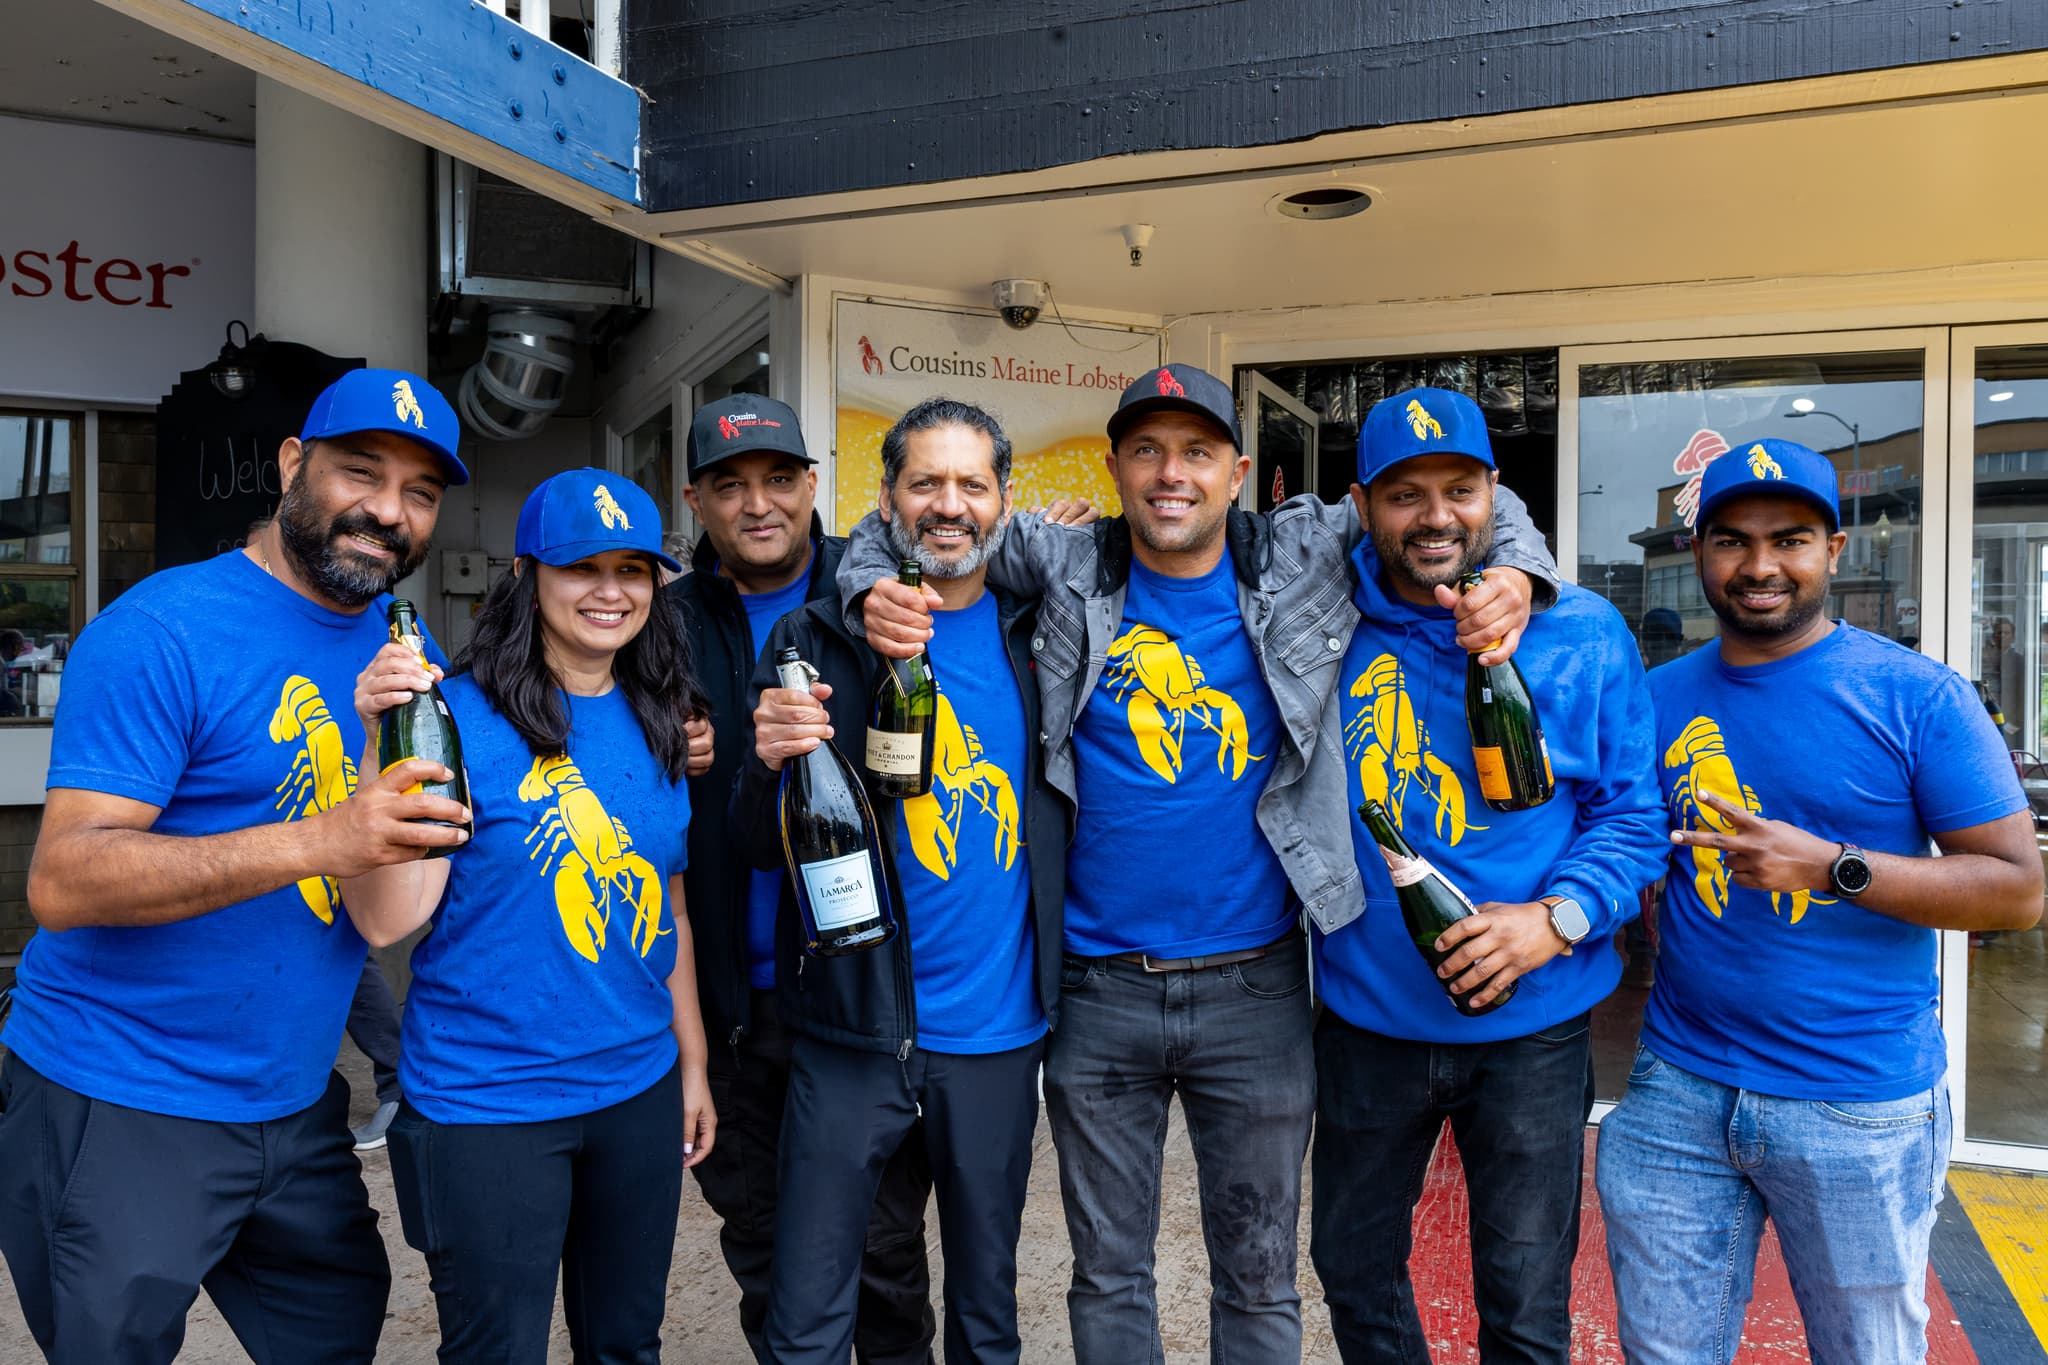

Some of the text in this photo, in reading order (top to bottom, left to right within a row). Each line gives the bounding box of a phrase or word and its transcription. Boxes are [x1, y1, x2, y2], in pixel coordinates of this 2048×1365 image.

[0, 240, 191, 309] ster
[889, 346, 1136, 391] Cousins Maine Lobste
[728, 412, 757, 423] Cousins
[200, 436, 279, 500] Welc
[882, 752, 915, 761] CHANDON
